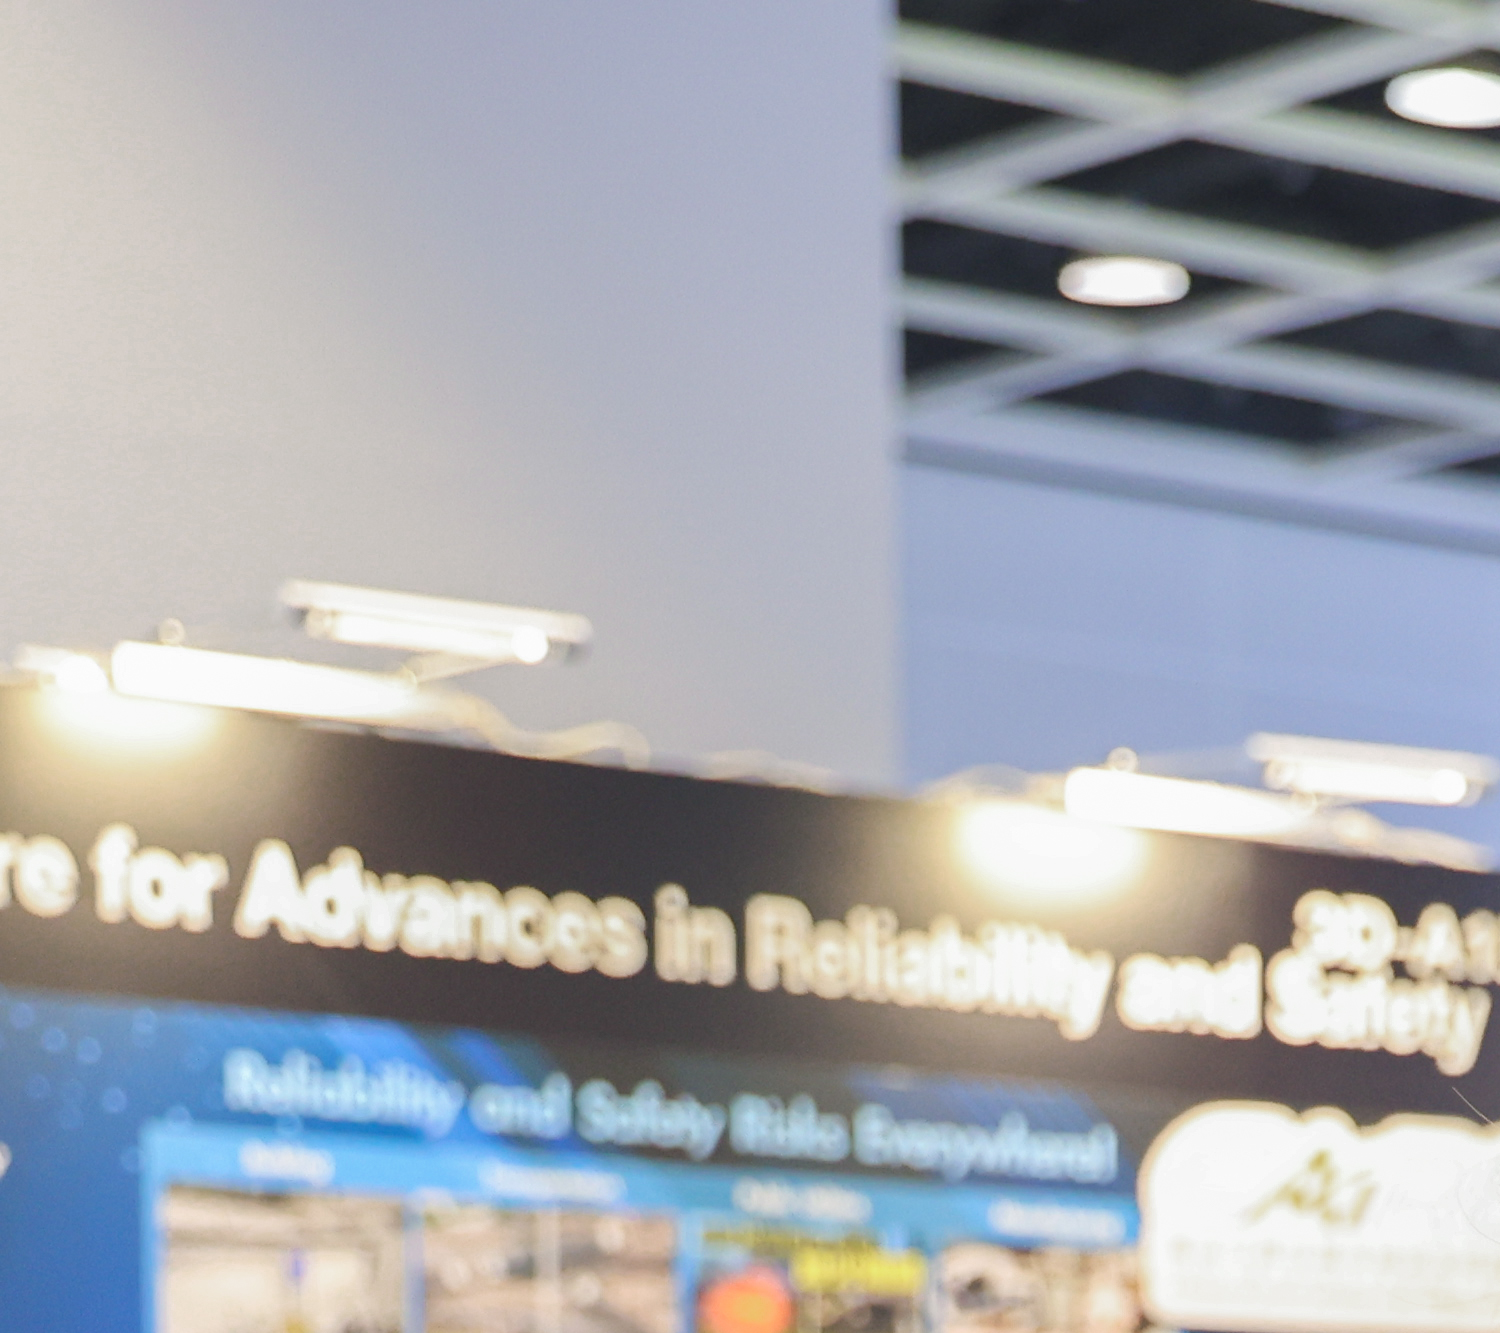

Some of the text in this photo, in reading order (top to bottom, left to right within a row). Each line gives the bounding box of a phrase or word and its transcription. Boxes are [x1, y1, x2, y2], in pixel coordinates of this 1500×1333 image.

[90, 823, 229, 933] for
[234, 838, 648, 978] Advances
[654, 883, 738, 988] in
[744, 893, 1114, 1041] Reliability
[1117, 944, 1263, 1039] and
[1266, 948, 1492, 1076] Safety
[222, 1046, 465, 1139] Reliability
[468, 1070, 574, 1141] and
[576, 1077, 726, 1160] Safety
